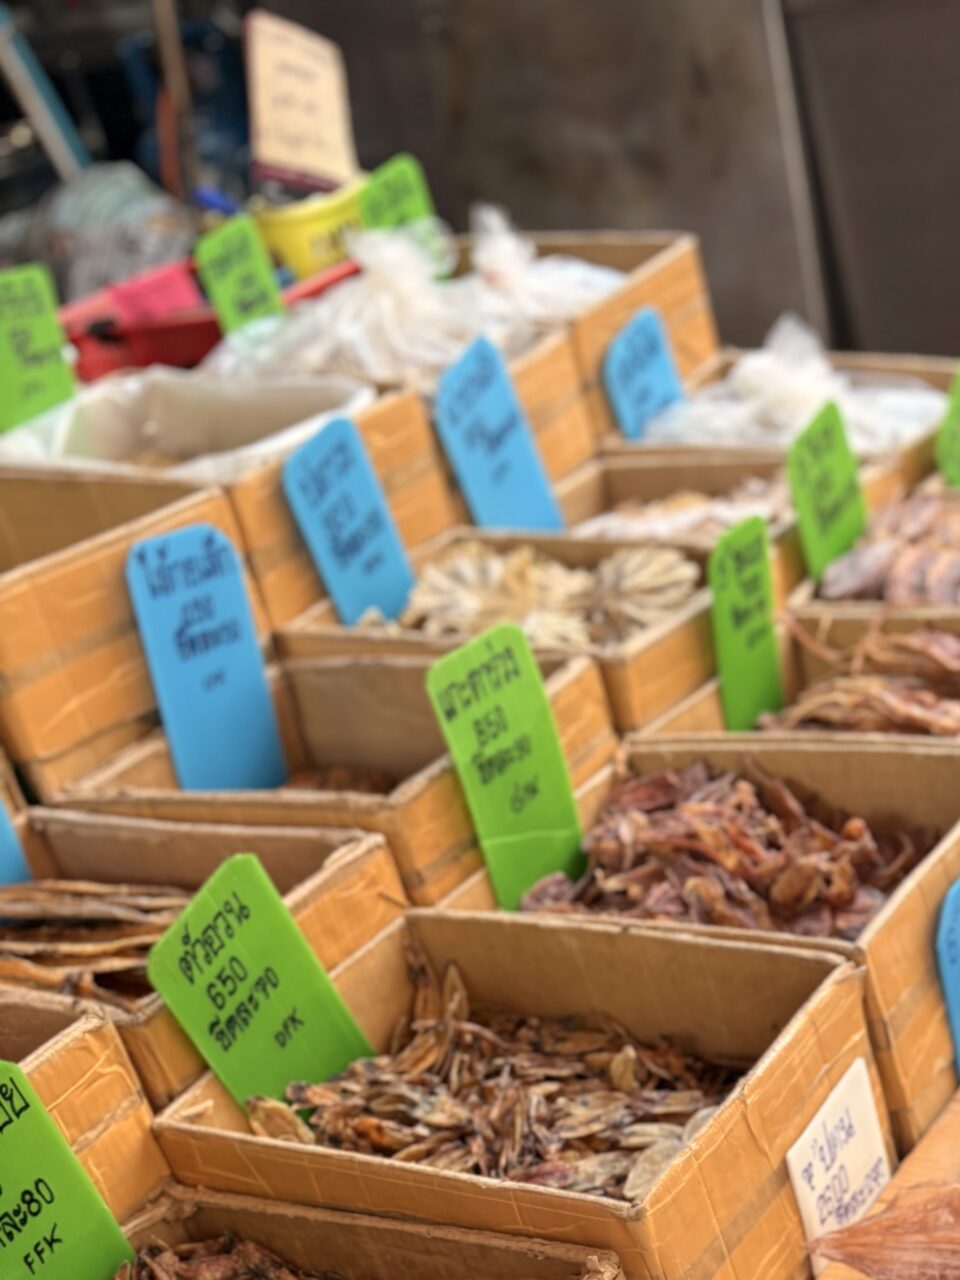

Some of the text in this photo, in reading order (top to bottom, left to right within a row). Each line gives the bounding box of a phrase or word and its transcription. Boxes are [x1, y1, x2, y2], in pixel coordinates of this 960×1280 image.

[206, 955, 249, 1011] 650
[0, 1177, 56, 1248] ละ80
[23, 1222, 64, 1276] FFK
